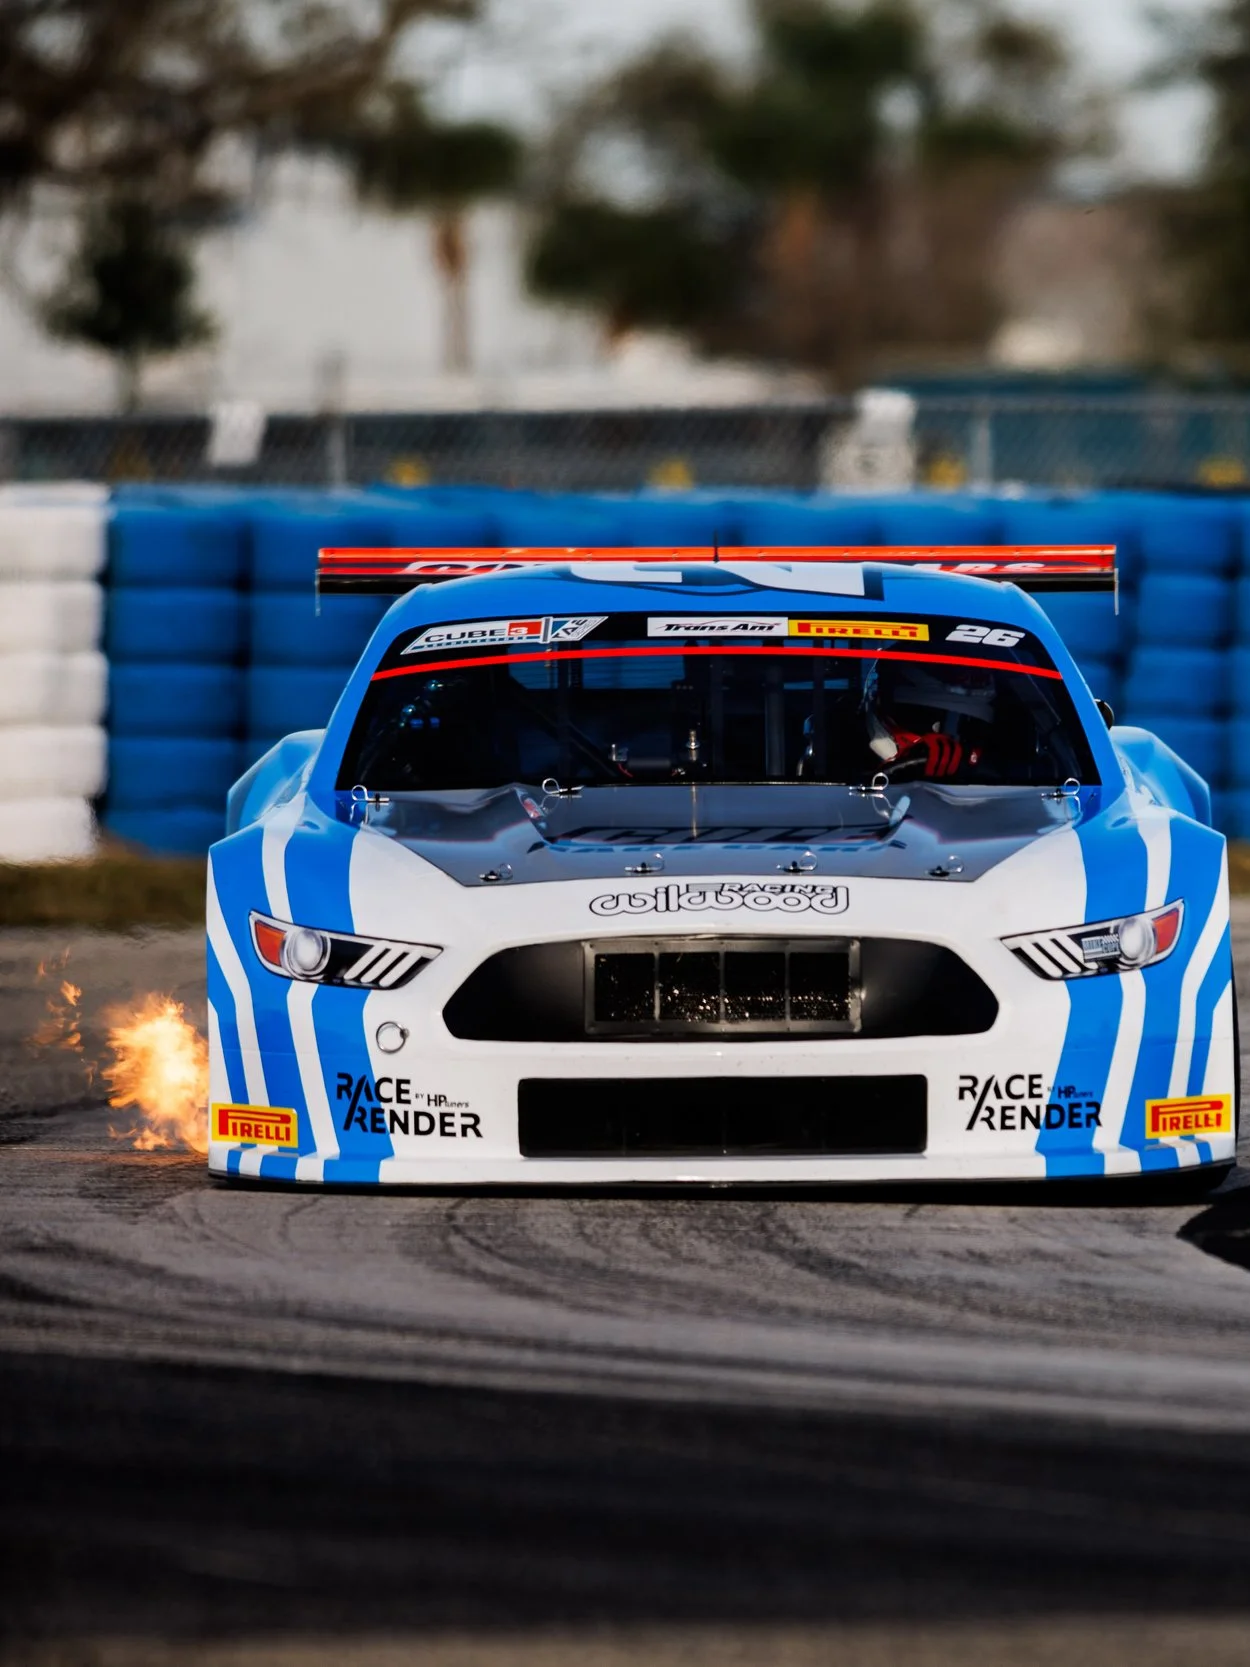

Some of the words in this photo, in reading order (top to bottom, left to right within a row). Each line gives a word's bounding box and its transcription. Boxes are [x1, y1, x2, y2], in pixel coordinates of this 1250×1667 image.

[425, 628, 505, 643] CUBE
[510, 626, 528, 636] 3
[663, 623, 727, 632] Trans
[730, 623, 776, 632] Am
[797, 622, 918, 638] PIRELLI
[945, 624, 1026, 648] 26
[336, 1072, 411, 1105] RACE
[958, 1074, 1044, 1101] RACE
[218, 1108, 292, 1142] PIRELLI
[343, 1108, 484, 1139] RENDER
[965, 1101, 1103, 1131] RENDER
[1151, 1100, 1224, 1133] PIRELLI
